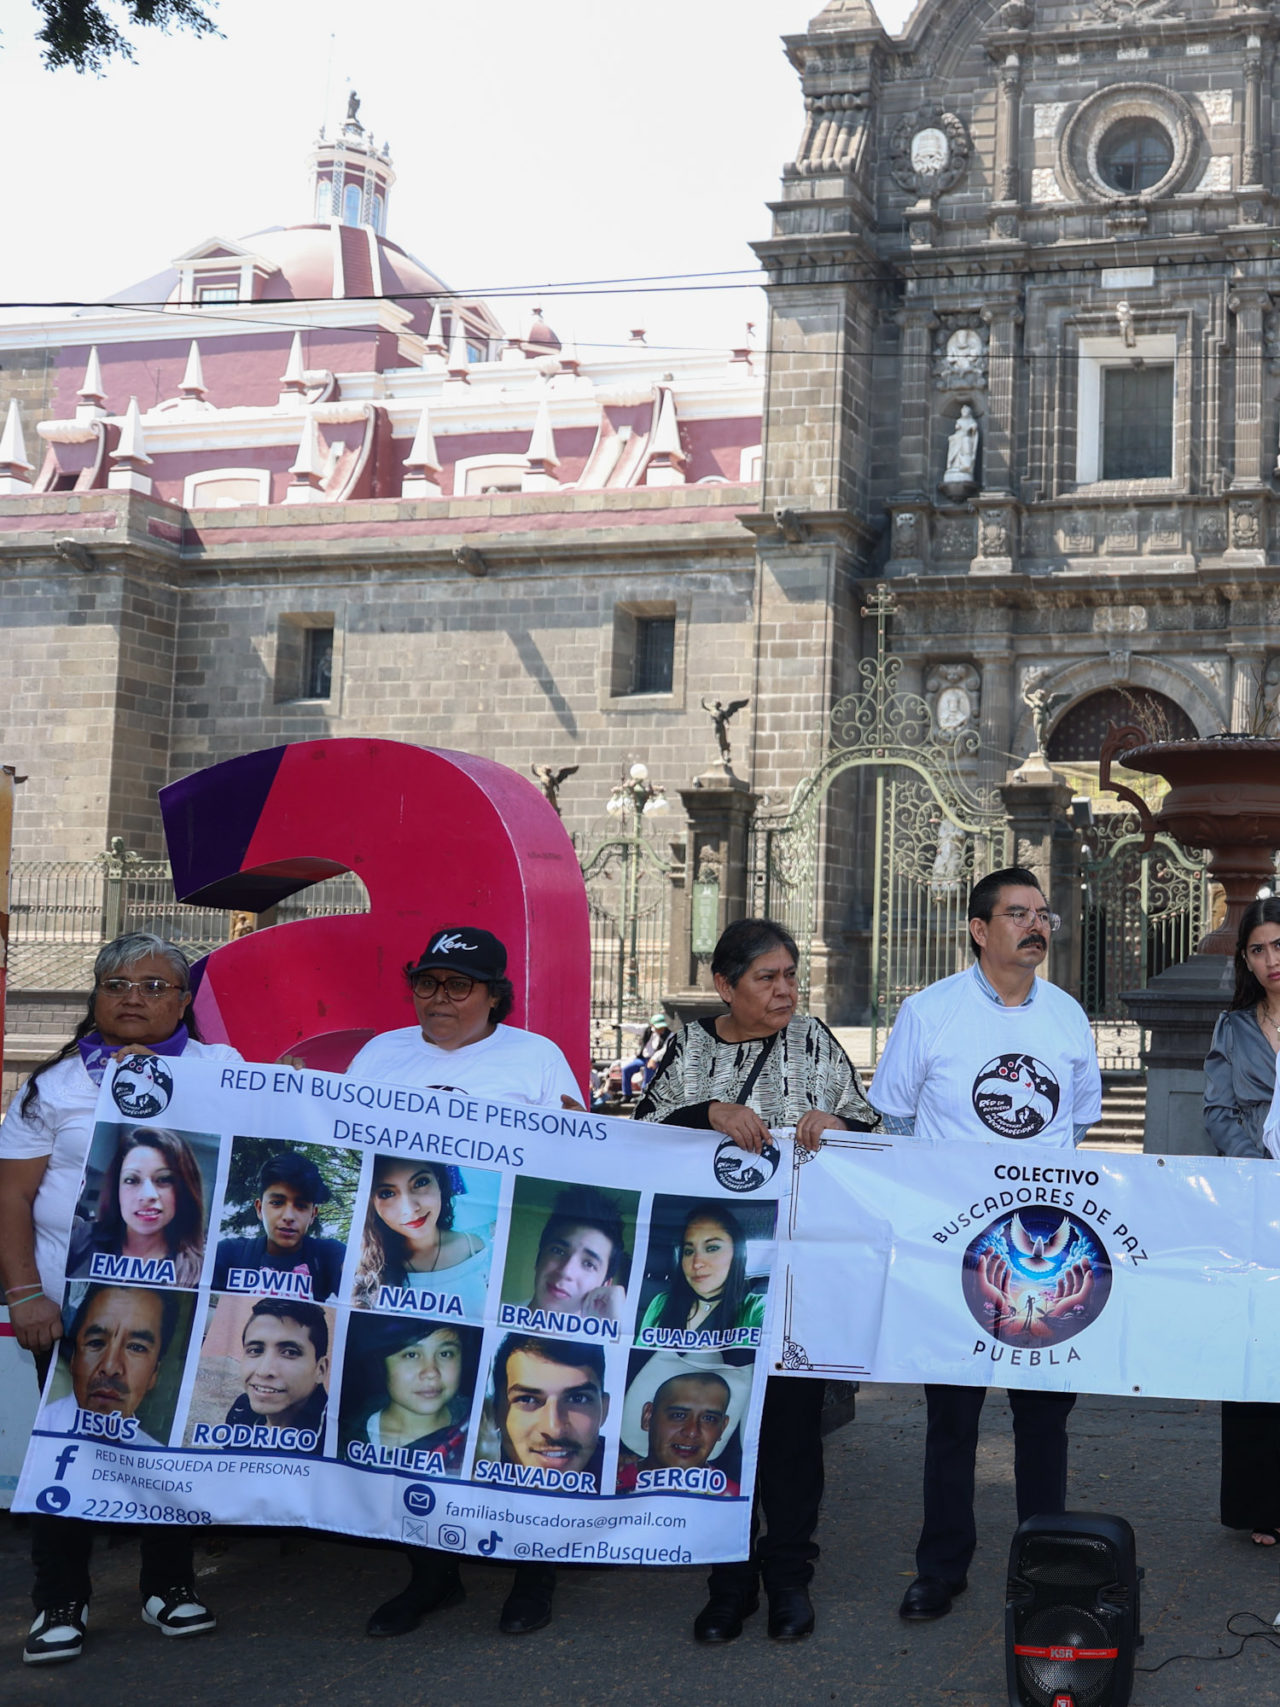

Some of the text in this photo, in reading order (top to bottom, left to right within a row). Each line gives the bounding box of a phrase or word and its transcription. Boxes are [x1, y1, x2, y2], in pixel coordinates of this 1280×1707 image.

[432, 933, 478, 953] Ken
[221, 1068, 608, 1142] RED EN BUSQUEDA DE PERSONAS
[333, 1120, 524, 1167] DESAPARECIDAS
[994, 1164, 1099, 1186] COLECTIVO
[932, 1187, 1150, 1267] BUSCADORES DE PAZ
[89, 1252, 177, 1283] EMMA
[227, 1268, 312, 1296] EDWIN
[378, 1284, 464, 1317] NADIA
[501, 1303, 619, 1340] BRANDON
[641, 1327, 761, 1348] GUADALUPE
[973, 1340, 1082, 1366] PUEBLA
[68, 1408, 140, 1441] JESÚS
[193, 1423, 319, 1452] RODRIGO
[96, 1449, 311, 1477] RED EN BUSQUEDA DE PERSONAS
[346, 1440, 446, 1475] GALILEA
[92, 1468, 192, 1494] DESAPARECIDAS
[474, 1460, 598, 1493] SALVADOR
[636, 1467, 727, 1493] SERGIO
[82, 1498, 212, 1526] 2229308808
[446, 1501, 687, 1530] familiasbuscadoras@gmail.com
[513, 1541, 692, 1565] @RedEnBusqueda
